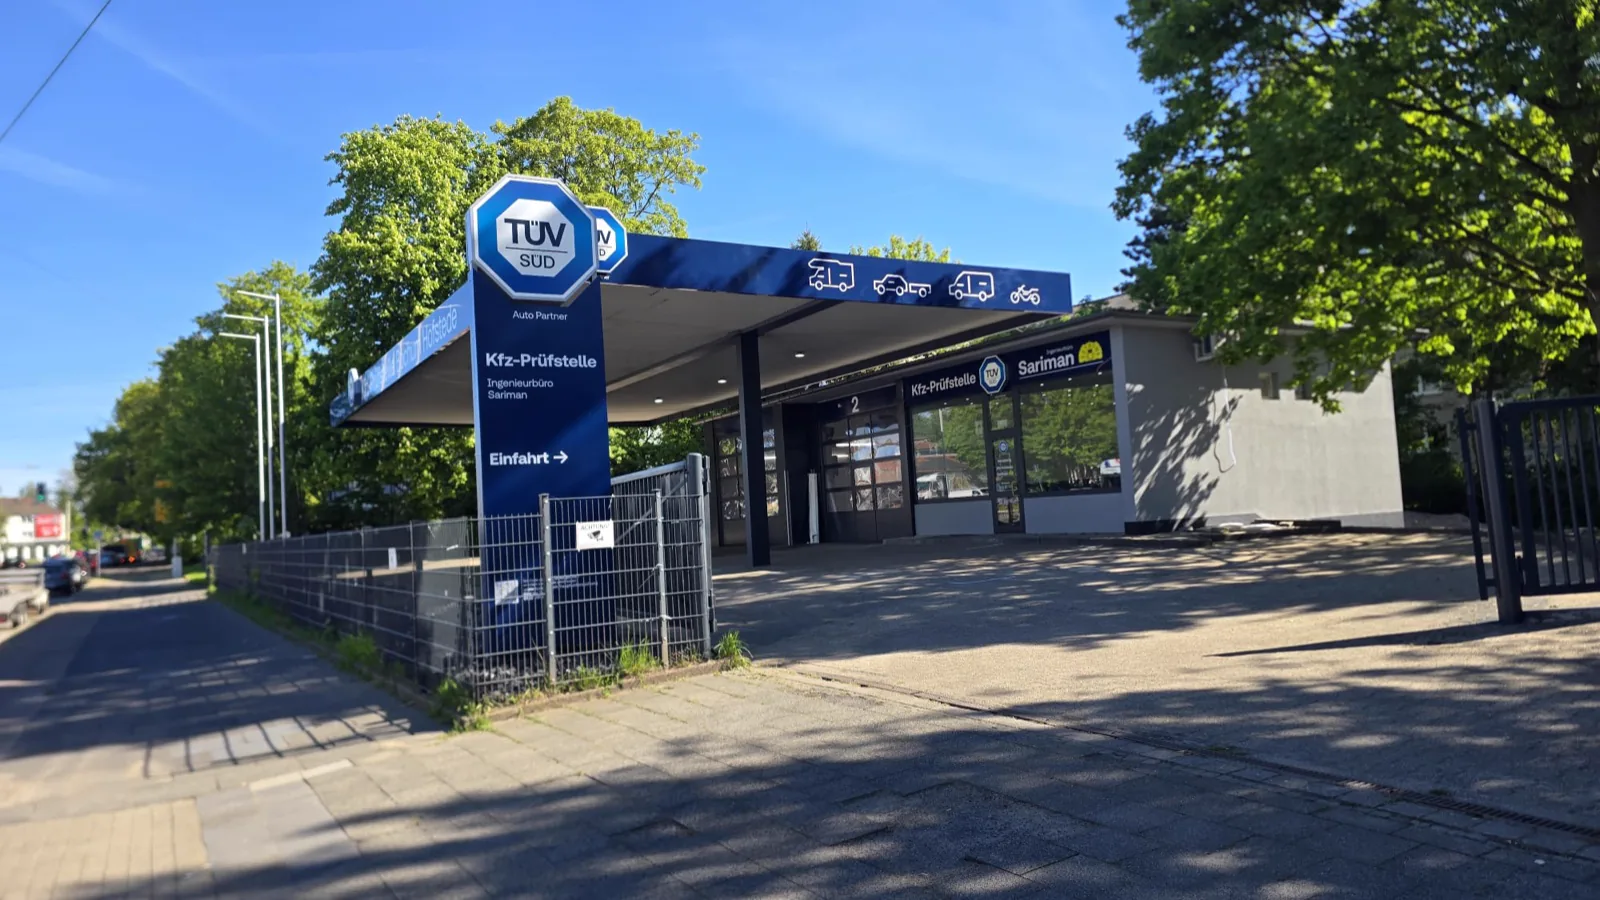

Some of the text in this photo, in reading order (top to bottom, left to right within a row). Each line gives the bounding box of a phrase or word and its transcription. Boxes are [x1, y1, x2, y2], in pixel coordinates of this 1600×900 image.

[504, 218, 567, 248] TÜV
[519, 253, 556, 269] SÜD
[512, 310, 568, 321] Auto Partner
[422, 304, 458, 353] Hofstede
[485, 352, 597, 368] Kfz-Prüfstelle
[1018, 352, 1075, 376] Sariman
[487, 378, 554, 390] Ingenieurbüro
[911, 372, 977, 397] Kfz-Prüfstelle
[488, 390, 528, 400] Sariman
[851, 396, 860, 413] 2
[489, 451, 550, 466] Einfahrt
